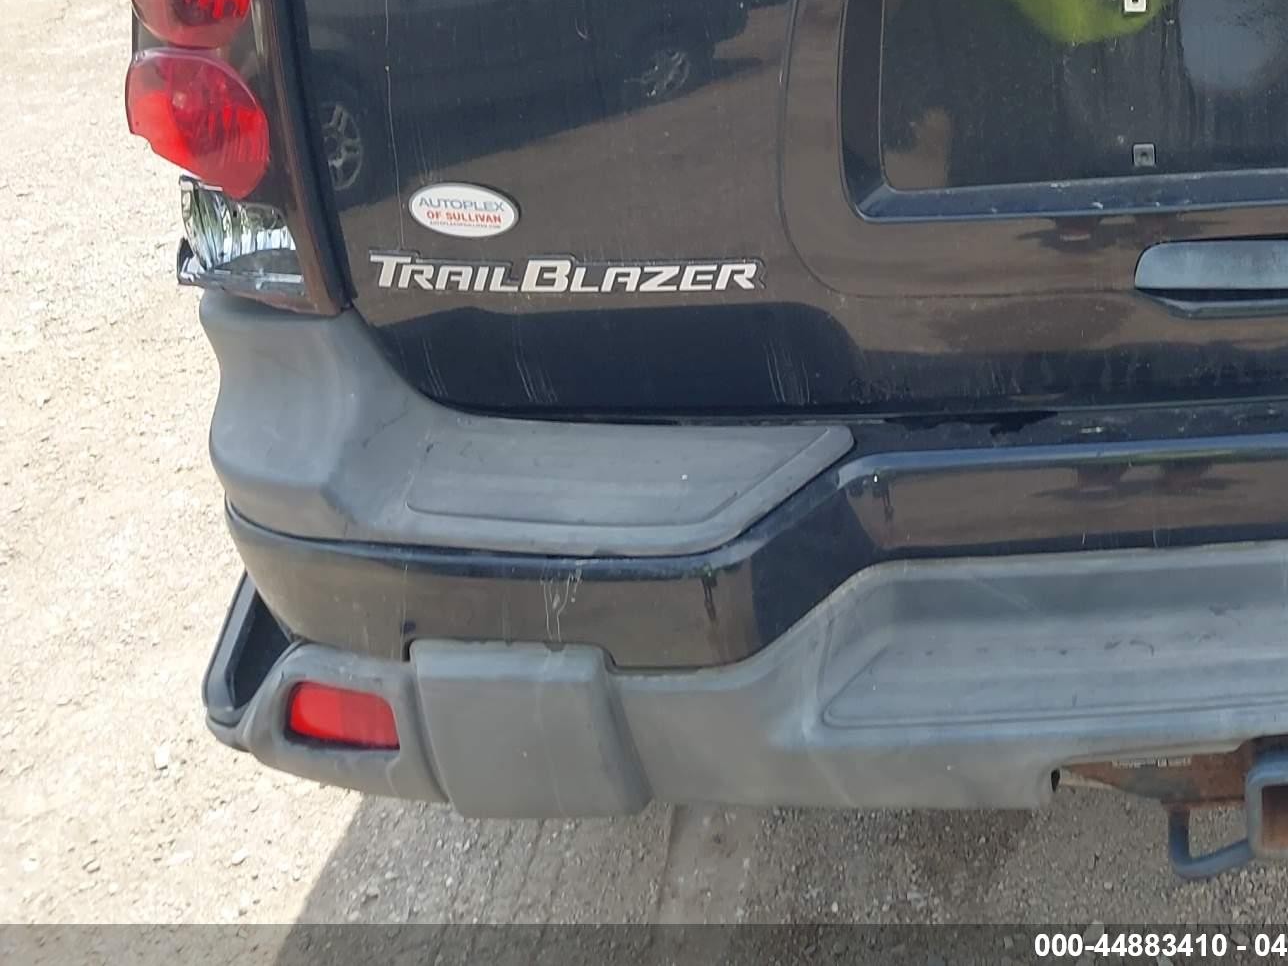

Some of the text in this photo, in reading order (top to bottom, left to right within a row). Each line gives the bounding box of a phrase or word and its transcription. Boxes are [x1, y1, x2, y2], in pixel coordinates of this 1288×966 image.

[418, 197, 505, 212] AUTOPLEX
[426, 209, 502, 224] OF SULLIVAN
